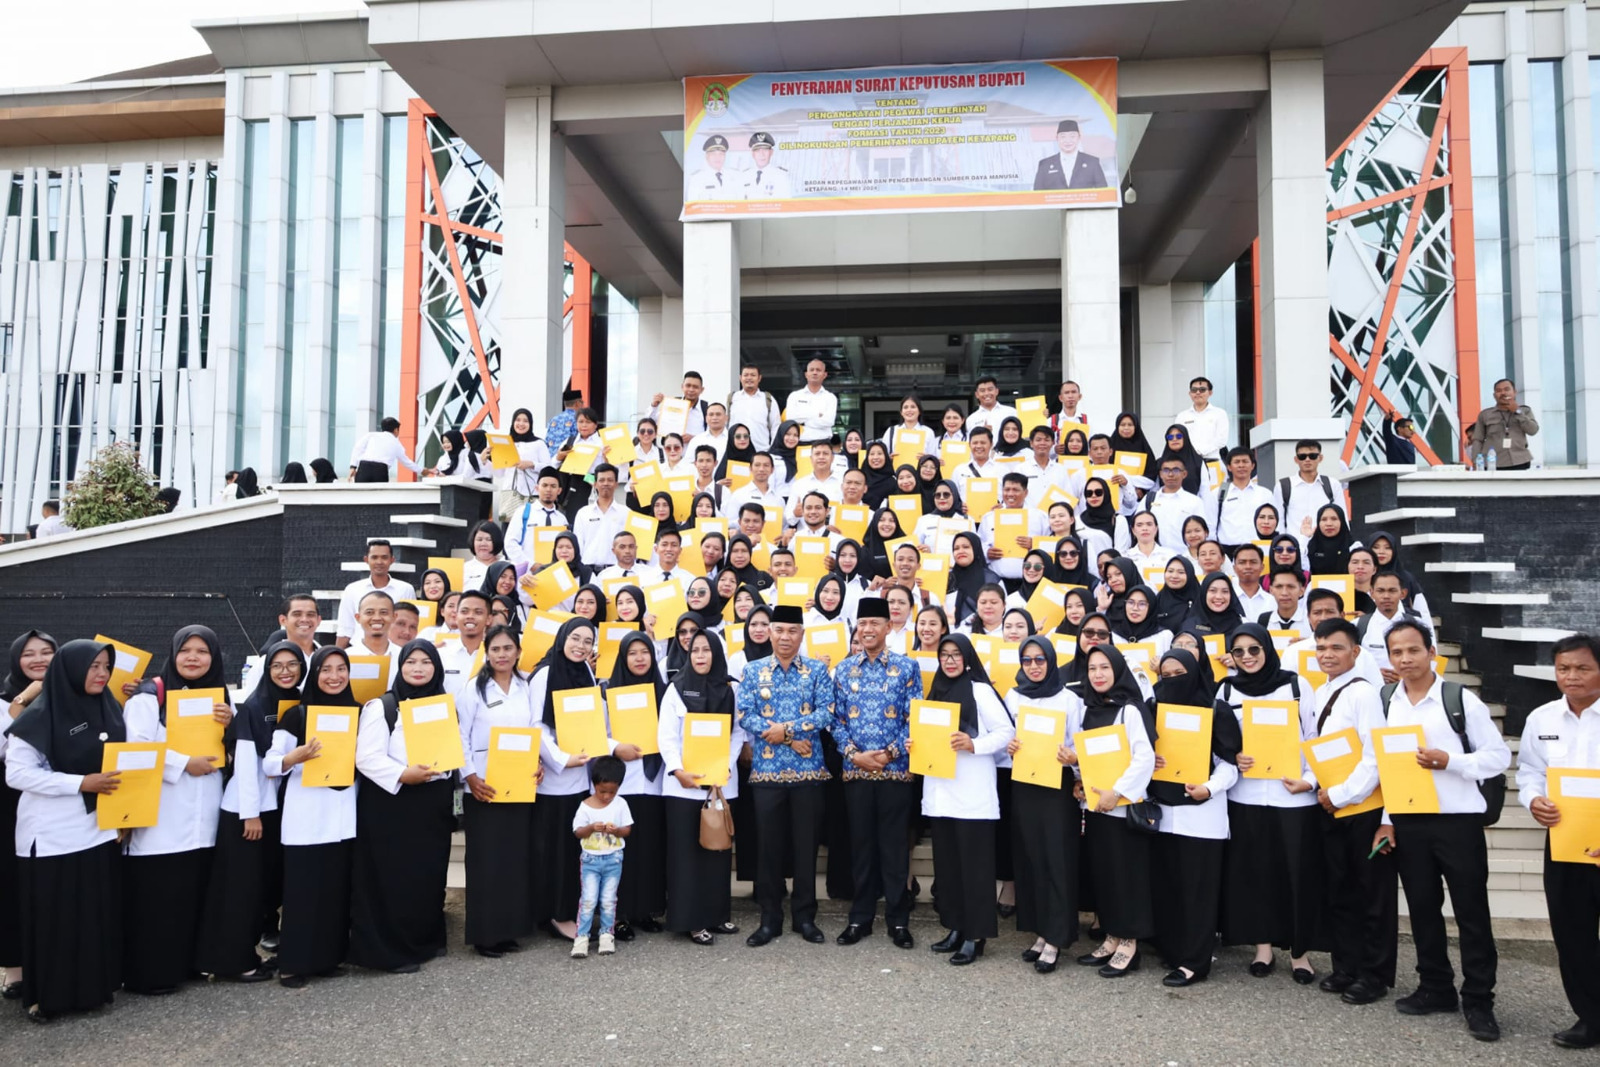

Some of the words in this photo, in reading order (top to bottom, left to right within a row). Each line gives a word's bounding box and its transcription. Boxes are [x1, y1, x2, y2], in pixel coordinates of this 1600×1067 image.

[771, 79, 852, 96] PENYERAHAN
[855, 77, 896, 93] SURAT
[899, 74, 975, 91] KEPUTUSAN
[978, 72, 1025, 88] BUPATI
[875, 98, 918, 107] TENTANG
[808, 109, 881, 119] PENGANGKATAN
[883, 107, 925, 117] PEGAWAI
[926, 105, 987, 115] PEMERINTAH
[832, 120, 870, 128] DENGAN
[872, 117, 929, 127] PERJANJIAN
[931, 116, 962, 124] KERJA
[847, 129, 889, 137] FORMASI
[891, 127, 922, 136] TAHUN
[924, 126, 946, 134] 2023
[779, 140, 848, 150] DILINGKUNGAN
[850, 138, 909, 148] PEMERINTAH
[911, 135, 965, 145] KABUPATEN
[967, 134, 1017, 143] KETAPANG
